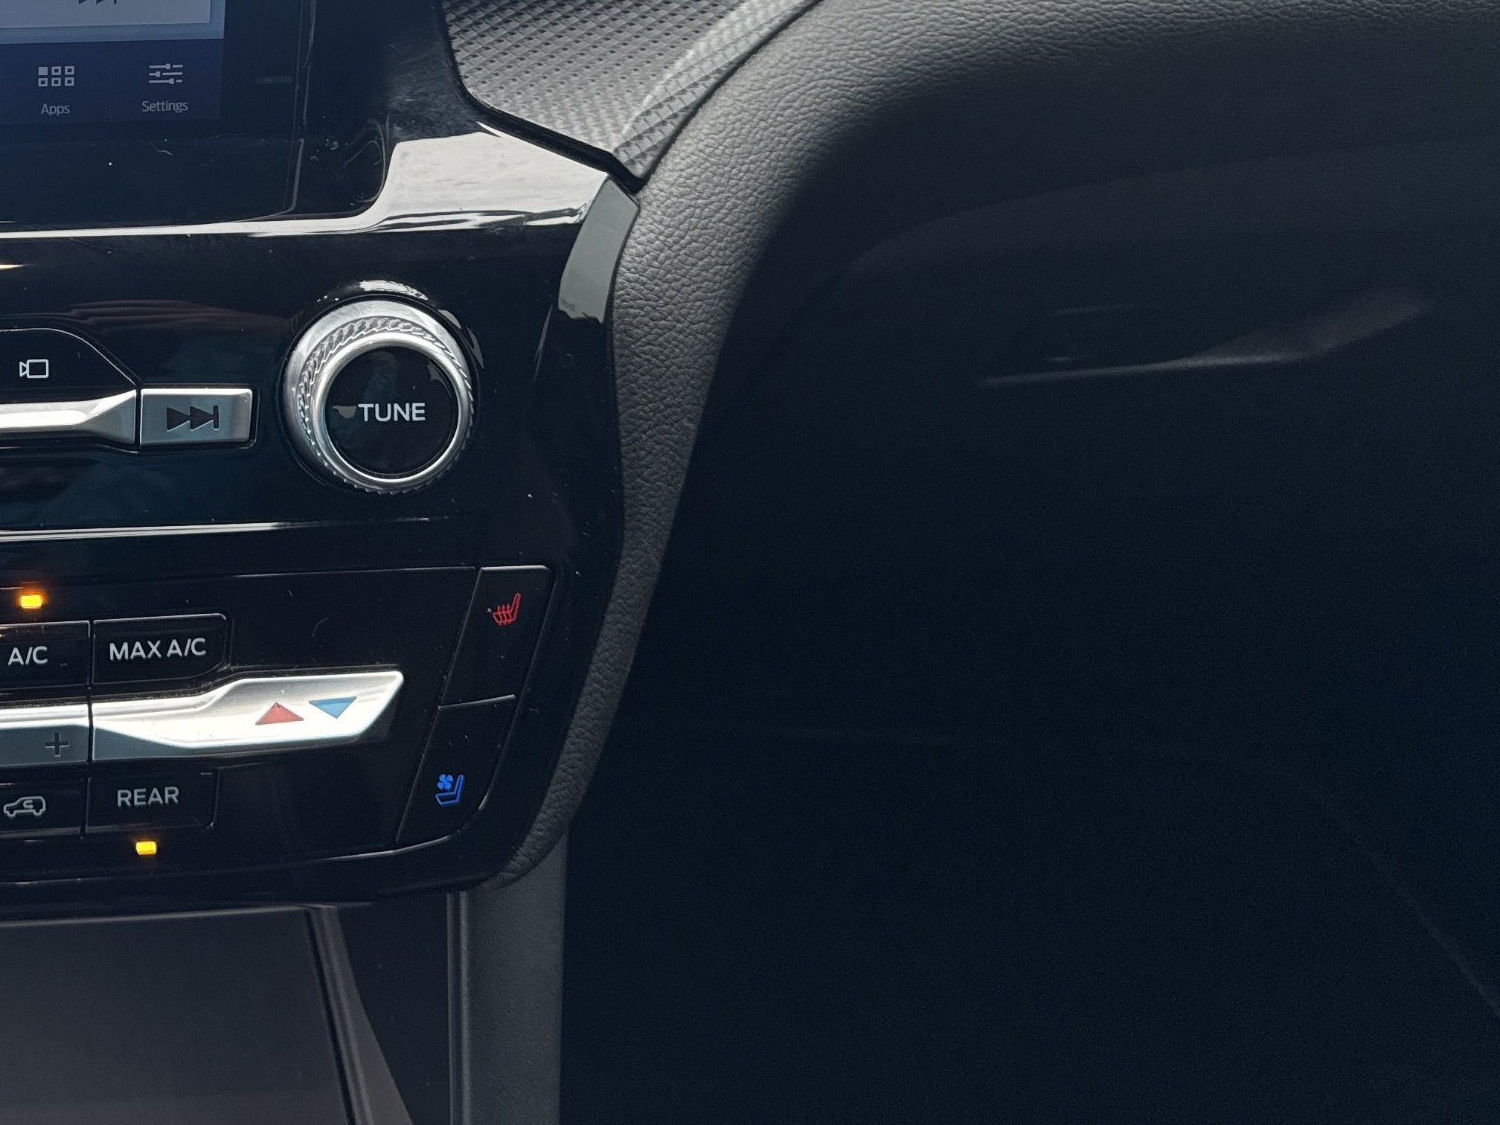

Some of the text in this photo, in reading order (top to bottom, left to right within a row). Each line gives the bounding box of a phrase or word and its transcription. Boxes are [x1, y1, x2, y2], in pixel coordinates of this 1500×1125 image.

[40, 103, 70, 116] Apps
[141, 99, 189, 114] Settings
[357, 401, 426, 423] TUNE
[7, 645, 49, 666] A/C
[109, 637, 207, 661] MAX A/C
[117, 786, 181, 808] REAR
